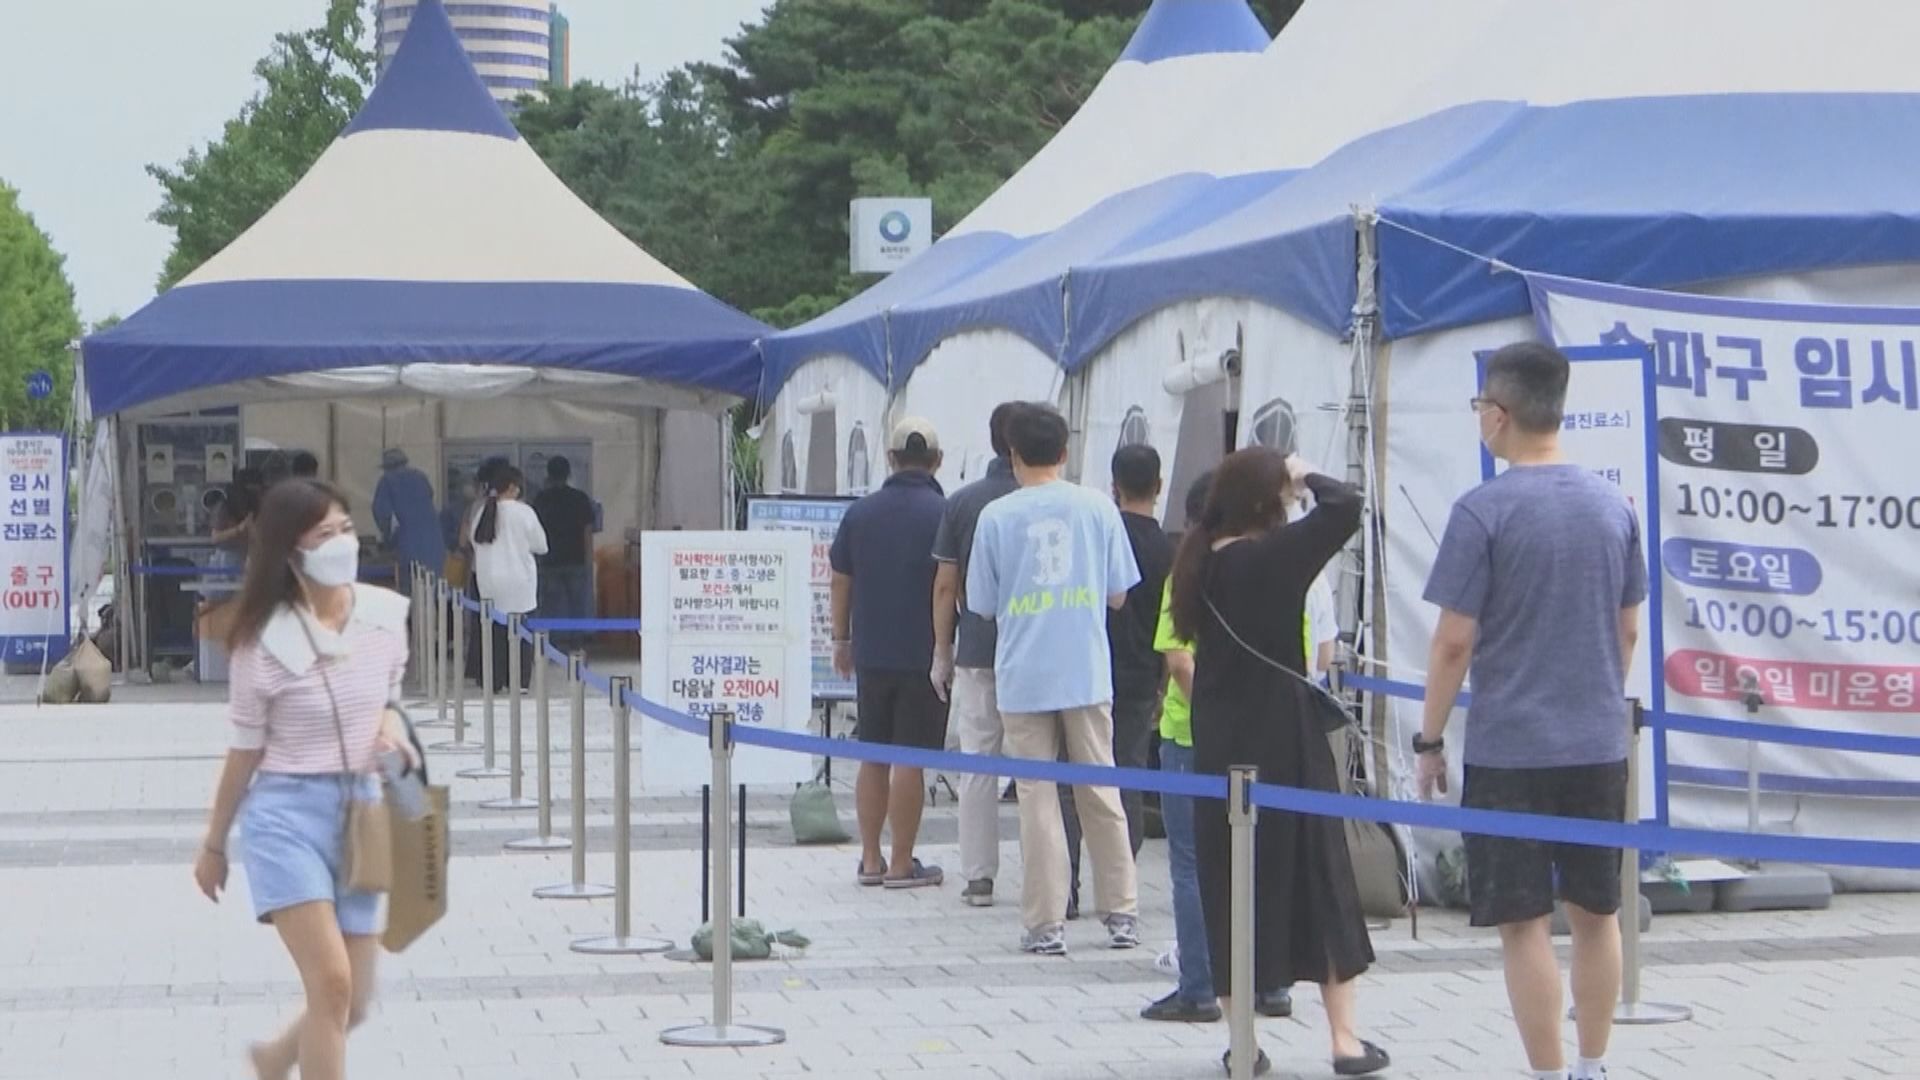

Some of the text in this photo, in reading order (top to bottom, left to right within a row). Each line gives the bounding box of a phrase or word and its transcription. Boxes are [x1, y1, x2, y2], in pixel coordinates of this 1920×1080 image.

[1794, 337, 1920, 411] 임시
[3, 523, 57, 541] 진료소
[1689, 547, 1792, 589] 토요일
[3, 589, 60, 609] (OUT)
[702, 583, 753, 597] 보건소에서
[691, 655, 762, 675] 검사결과는
[673, 678, 779, 698] 다음날 오전10시
[1695, 657, 1915, 708] 일요일 미운영
[736, 701, 764, 722] 전송
